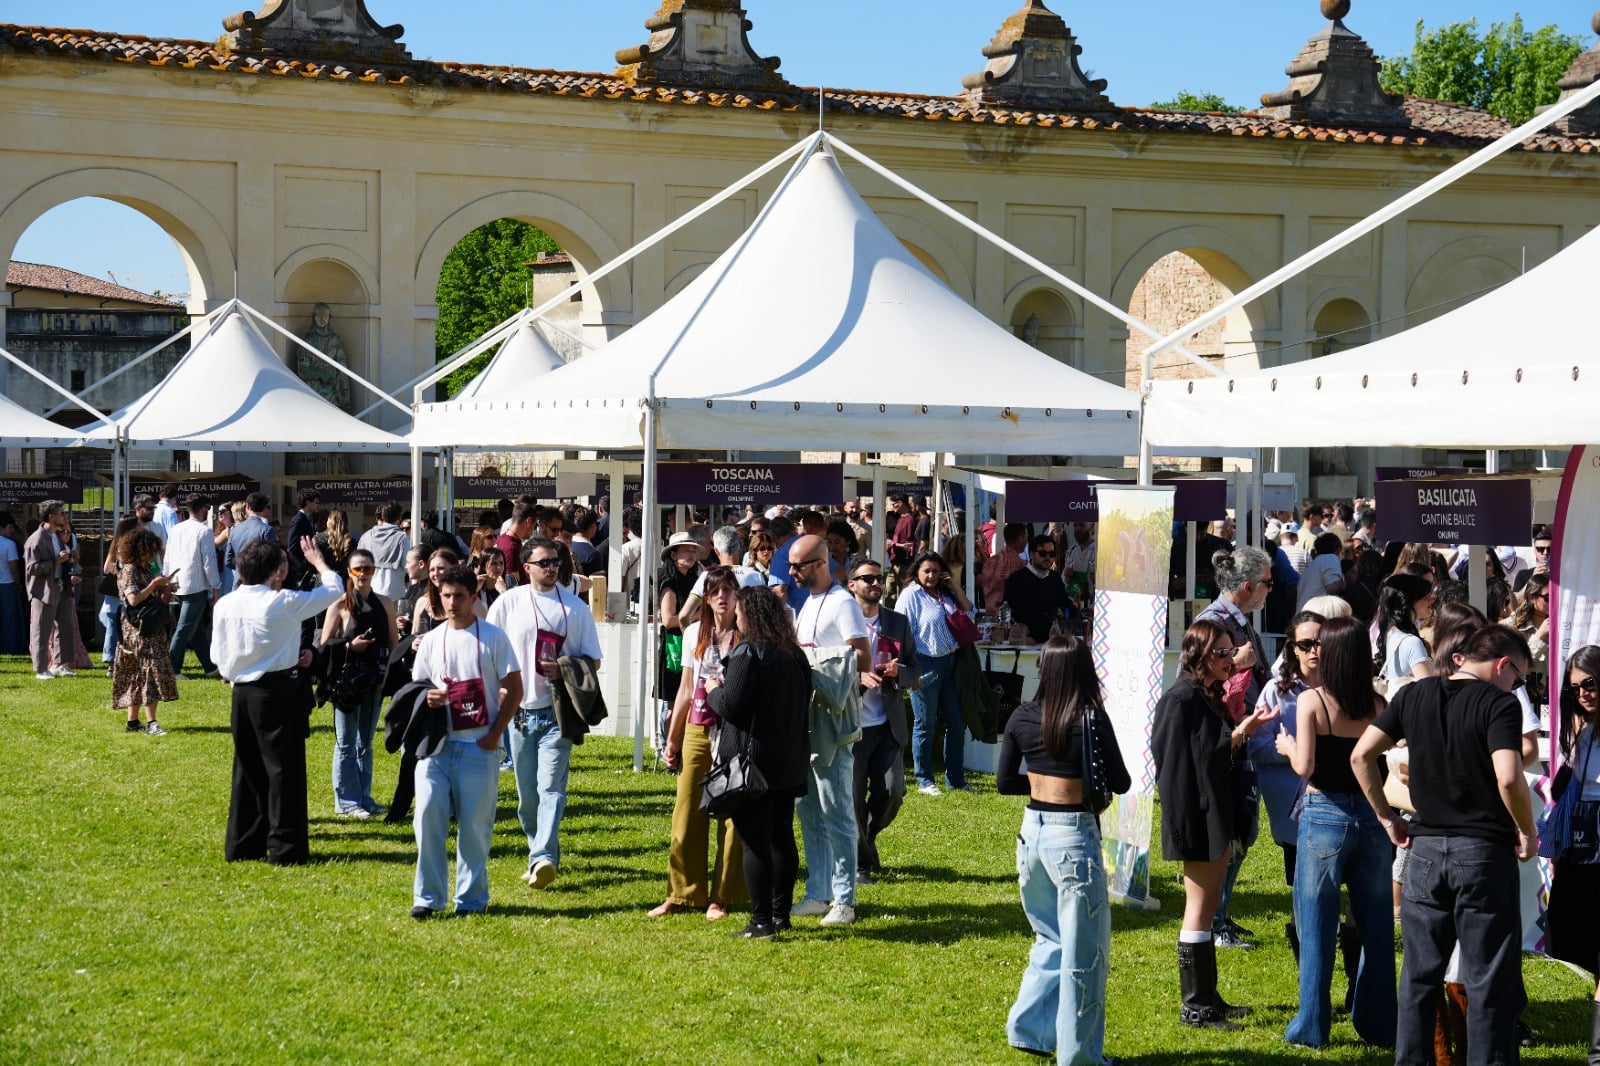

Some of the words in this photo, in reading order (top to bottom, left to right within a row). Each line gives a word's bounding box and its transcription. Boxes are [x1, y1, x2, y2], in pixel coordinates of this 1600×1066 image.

[711, 468, 774, 480] TOSCANA
[30, 481, 68, 489] UMBRIA
[314, 482, 352, 490] CANTINE
[353, 481, 381, 489] ALTRA
[468, 478, 504, 487] CANTINE
[506, 479, 532, 487] ALTRA
[533, 479, 557, 487] UMBR
[177, 483, 207, 492] ALTRA
[209, 483, 246, 491] UMBRIA
[705, 484, 741, 493] PODERE
[742, 484, 781, 493] FERRALE
[1417, 488, 1478, 507] BASILICATA
[1421, 513, 1453, 526] CANTINE
[1453, 513, 1476, 526] BALICE
